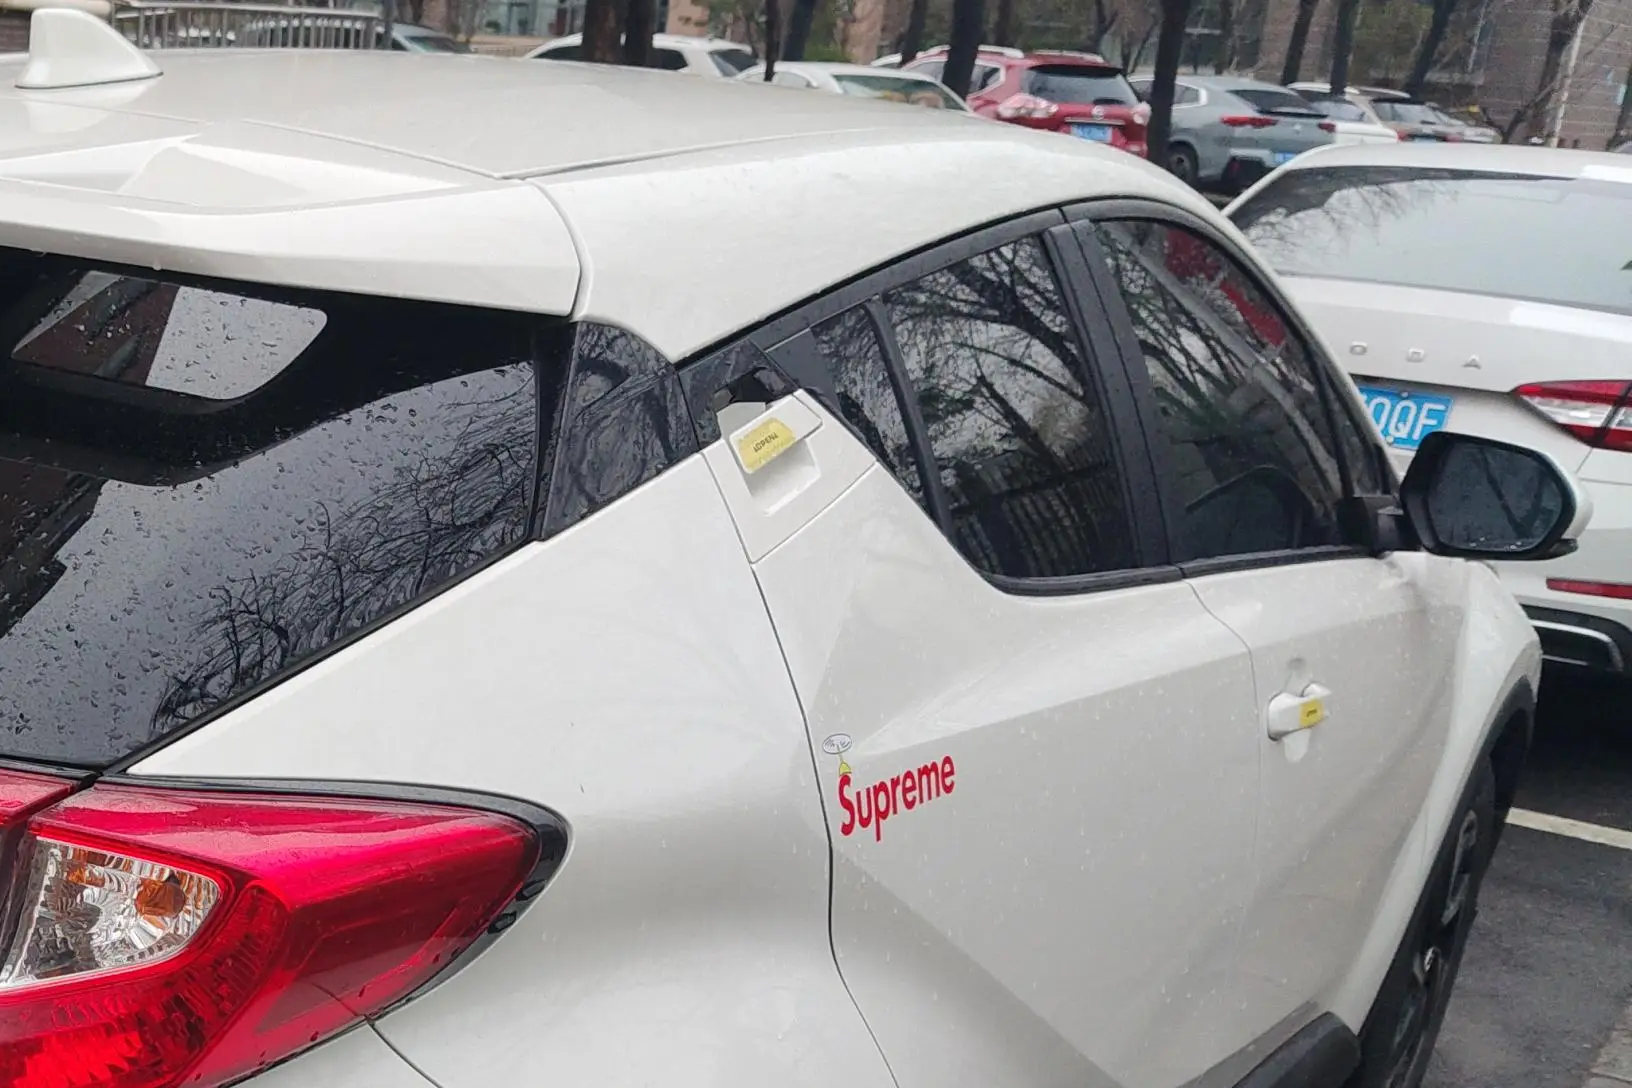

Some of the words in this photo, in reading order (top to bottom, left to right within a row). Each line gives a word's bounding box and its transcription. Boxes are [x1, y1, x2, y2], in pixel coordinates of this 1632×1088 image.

[1349, 341, 1481, 370] ODA
[1362, 395, 1446, 440] 0QF
[838, 755, 955, 842] Supreme
